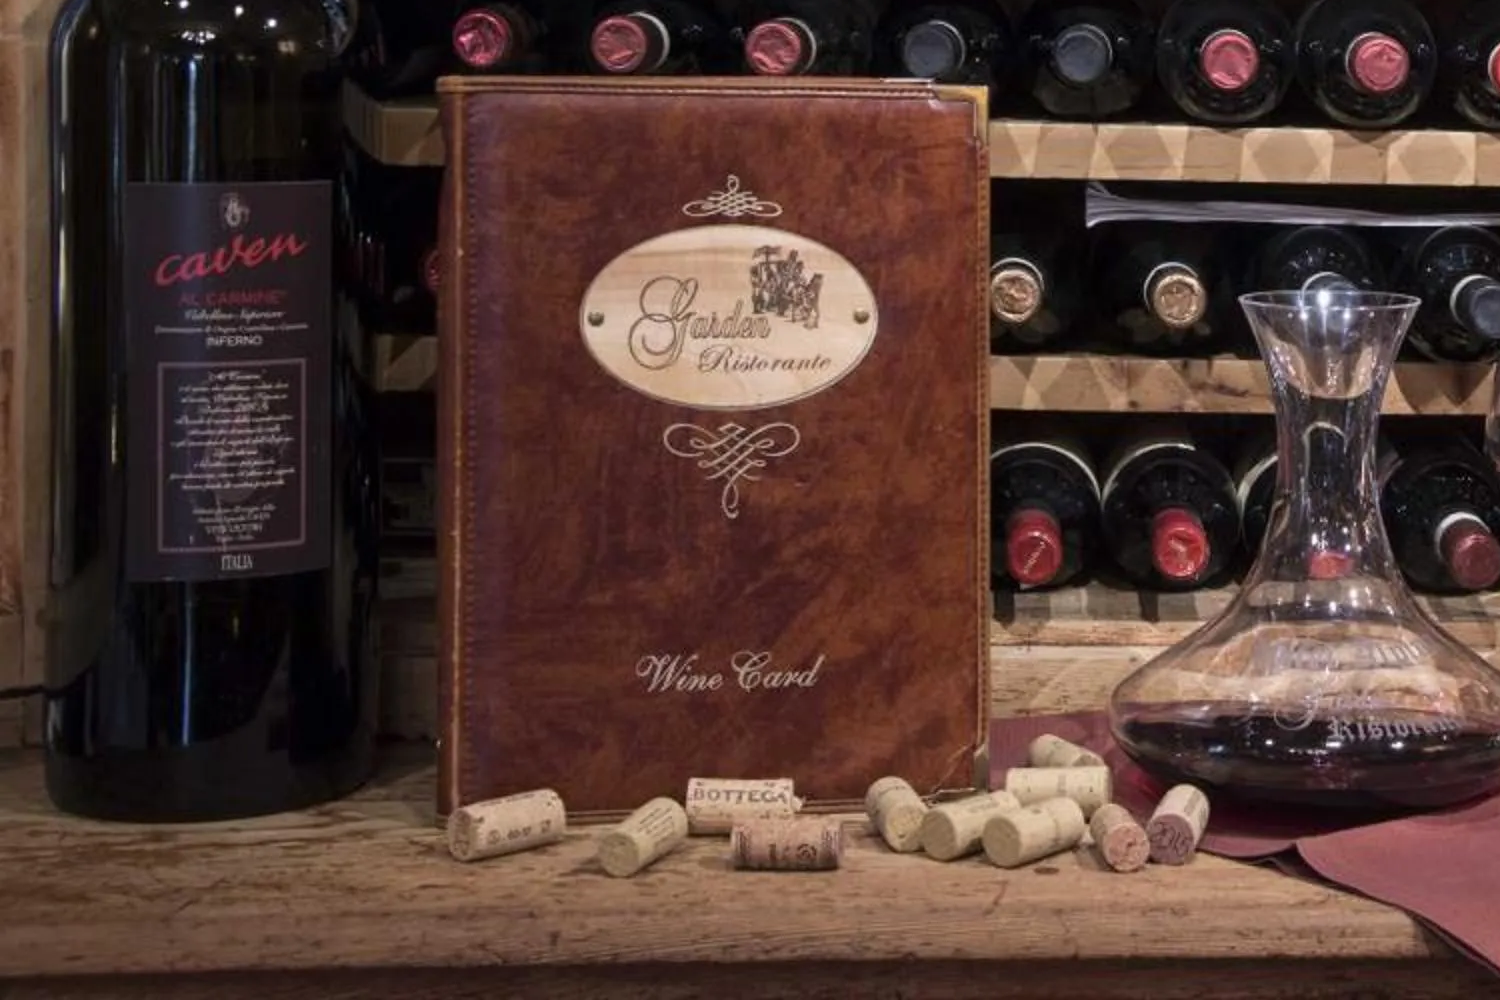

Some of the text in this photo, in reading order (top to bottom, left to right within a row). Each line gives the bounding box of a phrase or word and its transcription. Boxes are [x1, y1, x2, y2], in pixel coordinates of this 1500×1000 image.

[154, 231, 309, 287] caven
[205, 334, 264, 348] INFERNO
[628, 274, 772, 372] Garden
[697, 344, 833, 374] Ristorante
[635, 650, 827, 693] Wine Card
[693, 787, 788, 806] BOTTEGA
